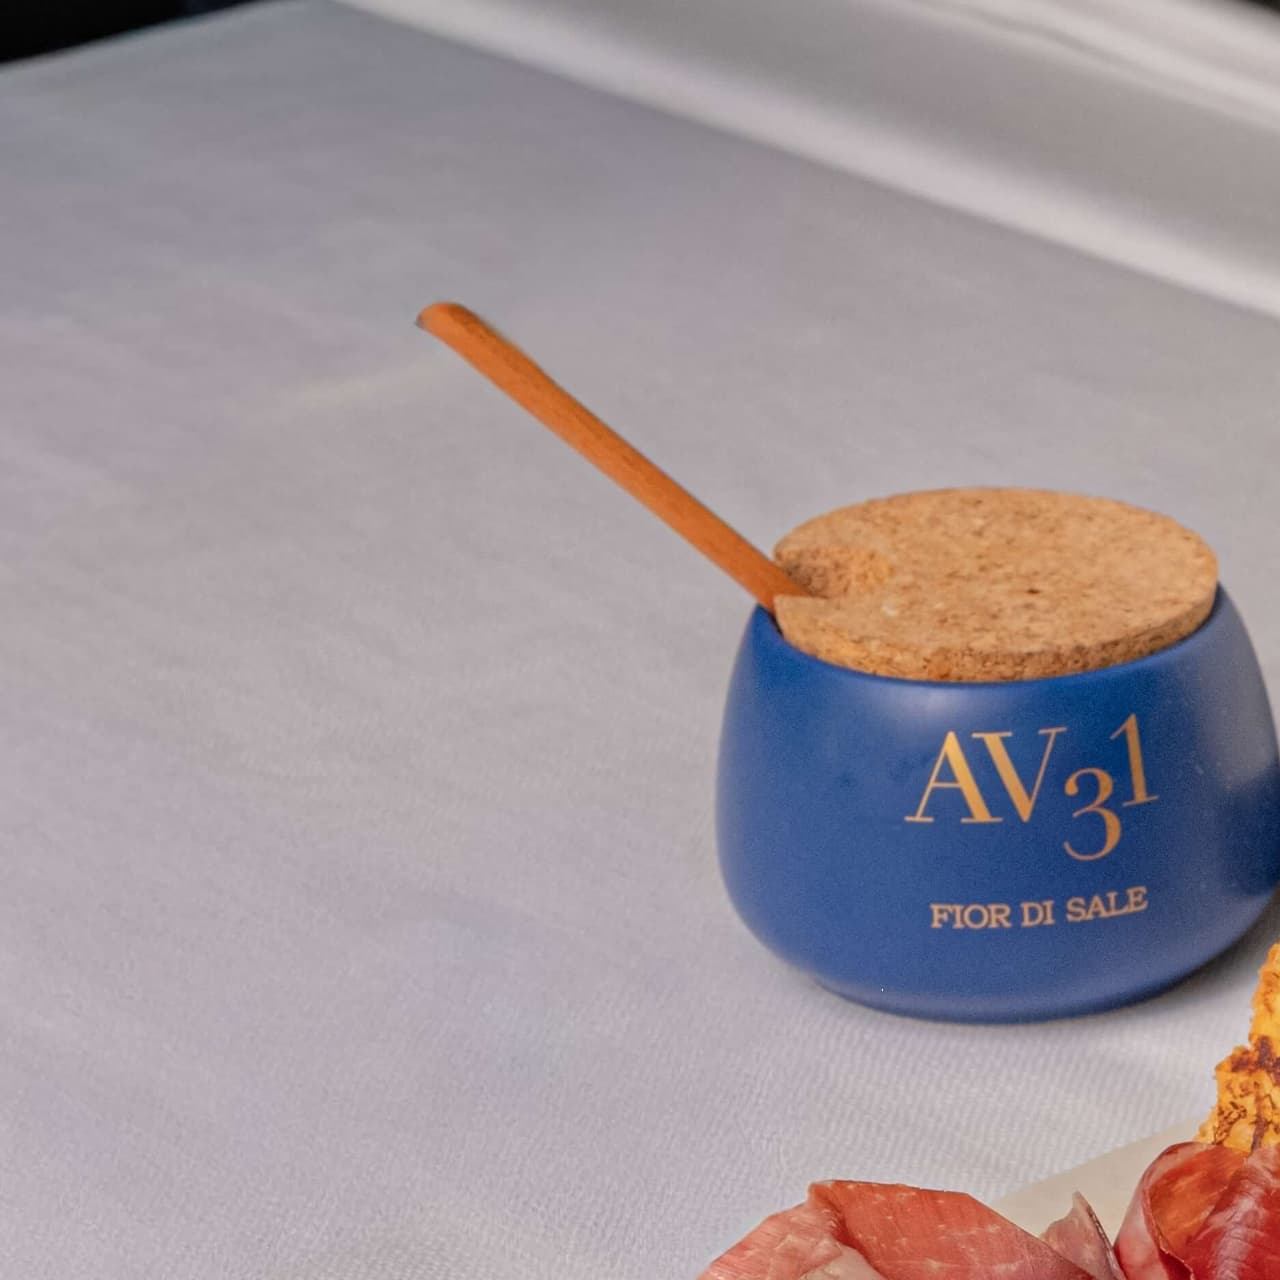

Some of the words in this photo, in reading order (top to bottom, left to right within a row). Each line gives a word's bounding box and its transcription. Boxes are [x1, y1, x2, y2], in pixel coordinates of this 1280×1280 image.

[904, 712, 1159, 862] AV31
[929, 902, 1012, 930] FIOR
[1021, 900, 1055, 927] DI
[1065, 886, 1149, 923] SALE
